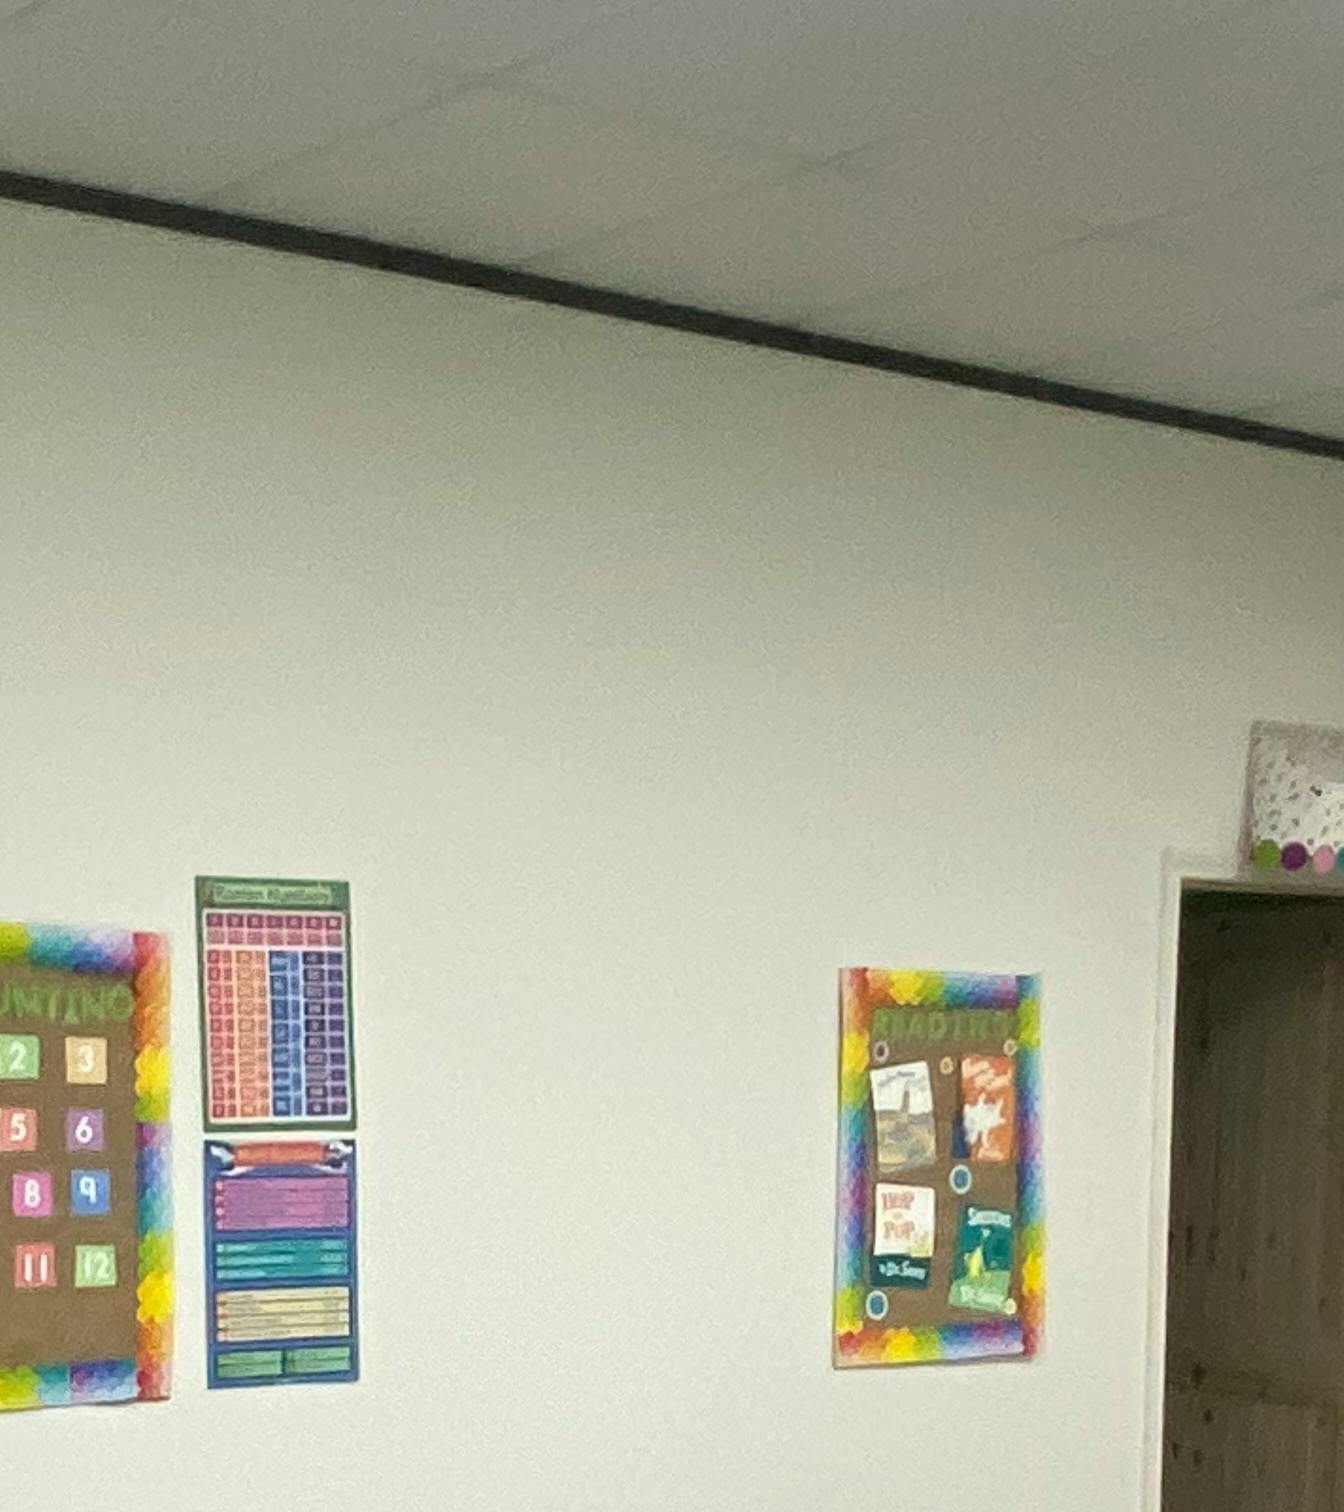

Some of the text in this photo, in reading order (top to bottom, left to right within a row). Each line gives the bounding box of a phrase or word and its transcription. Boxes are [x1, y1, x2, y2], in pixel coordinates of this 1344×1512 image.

[9, 1041, 26, 1071] 2
[77, 1044, 95, 1073] 3
[9, 1113, 27, 1142] 5
[74, 1115, 93, 1145] 6
[23, 1180, 40, 1209] 8
[79, 1176, 98, 1206] 9
[23, 1252, 49, 1282] 11
[83, 1251, 111, 1280] 12
